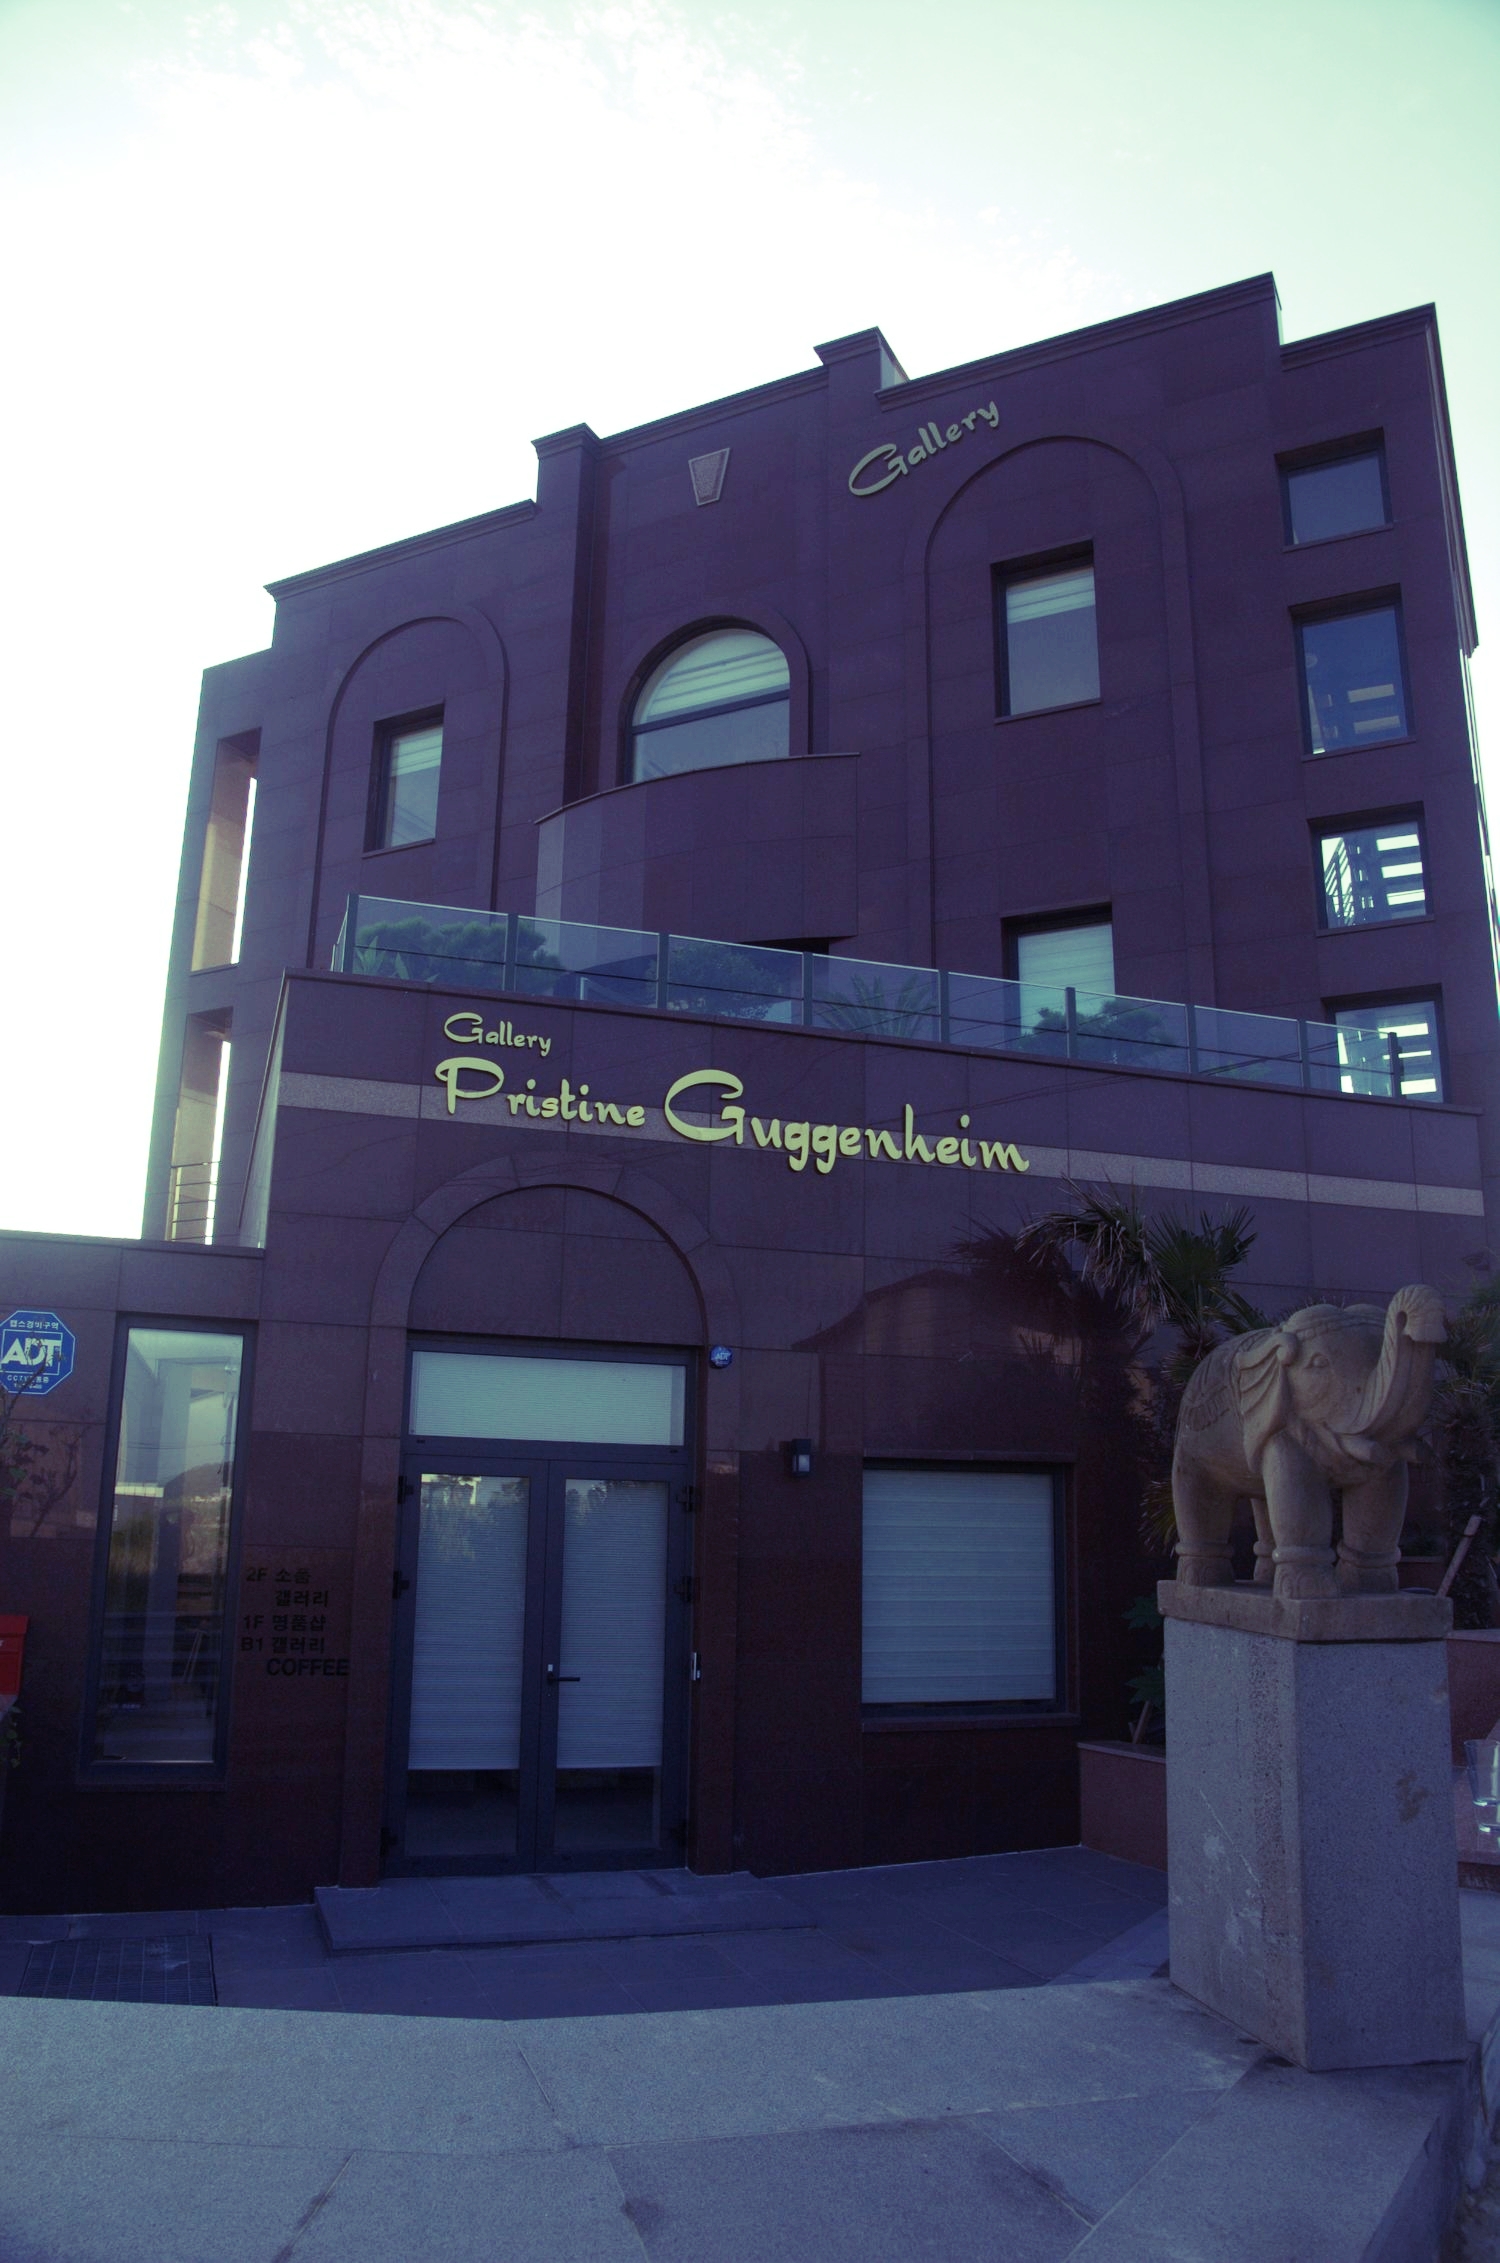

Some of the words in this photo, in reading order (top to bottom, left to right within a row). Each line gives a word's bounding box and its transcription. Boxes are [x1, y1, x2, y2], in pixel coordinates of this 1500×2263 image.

[849, 401, 999, 496] Gallery
[444, 1012, 552, 1057] Gallery
[435, 1057, 646, 1128] Pristine
[664, 1069, 1030, 1175] Guggenheim
[1, 1338, 62, 1367] ADT
[246, 1567, 268, 1582] 2F
[275, 1590, 328, 1608] 갤러리
[243, 1615, 265, 1630] 1F
[272, 1614, 327, 1632] 명품샵
[241, 1637, 263, 1652] B1
[272, 1637, 325, 1655] 갤러리
[266, 1658, 350, 1676] COFFEE
